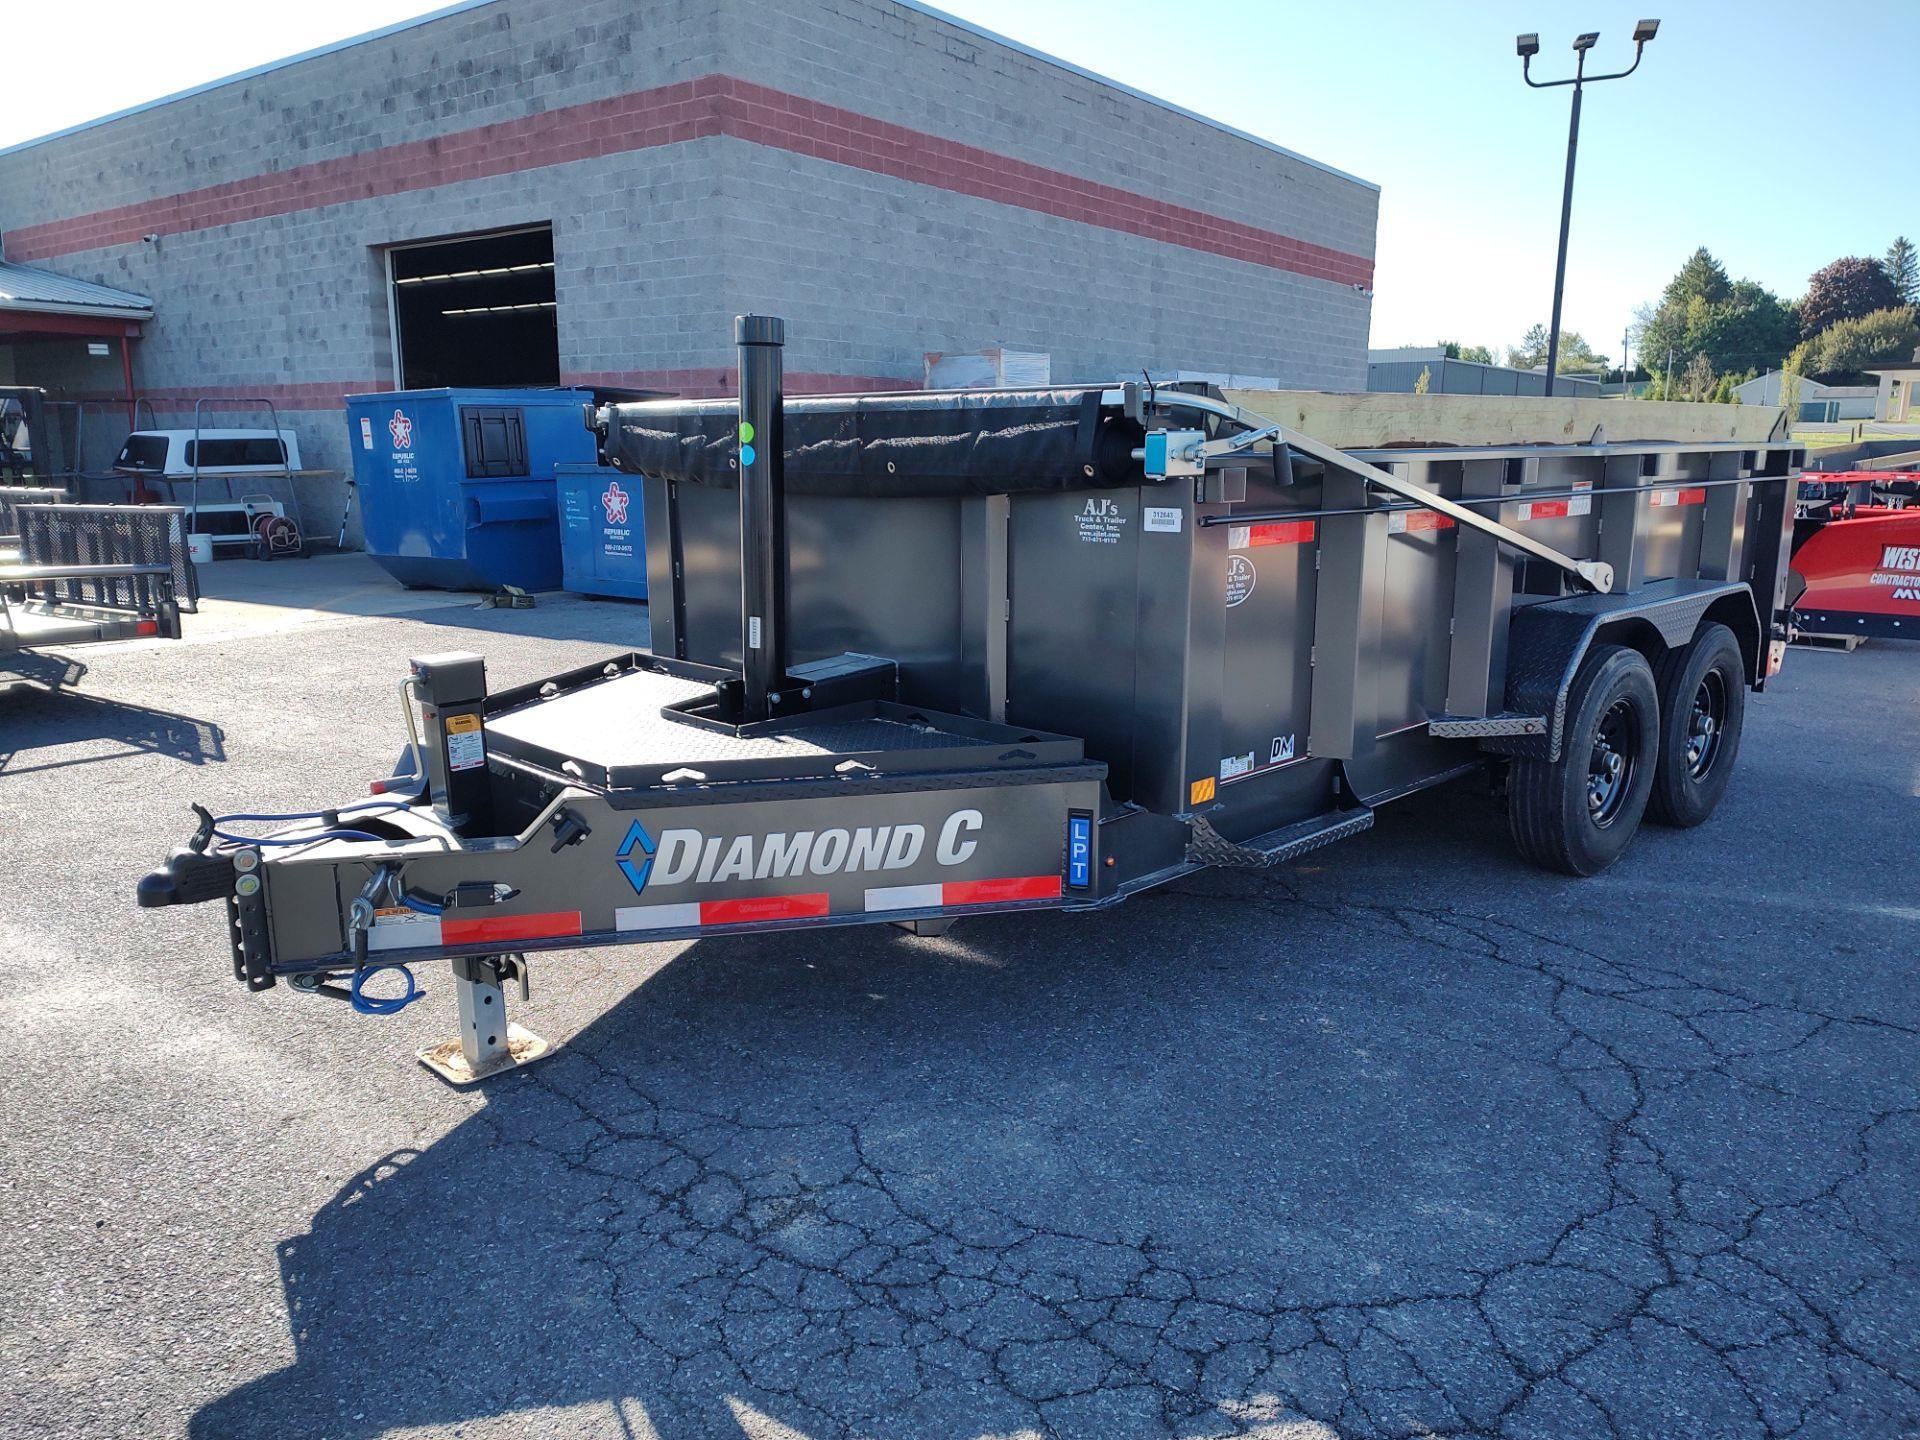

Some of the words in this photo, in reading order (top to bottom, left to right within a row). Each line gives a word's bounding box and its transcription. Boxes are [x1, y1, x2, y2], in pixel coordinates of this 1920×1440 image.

[392, 452, 415, 460] REPUBLIC
[1083, 498, 1118, 515] AJ's
[1103, 516, 1126, 524] Trailer
[604, 528, 630, 536] REPUBLIC
[1080, 523, 1105, 531] Center,
[1228, 558, 1245, 576] J's
[1272, 738, 1293, 757] DM
[936, 809, 983, 866] C
